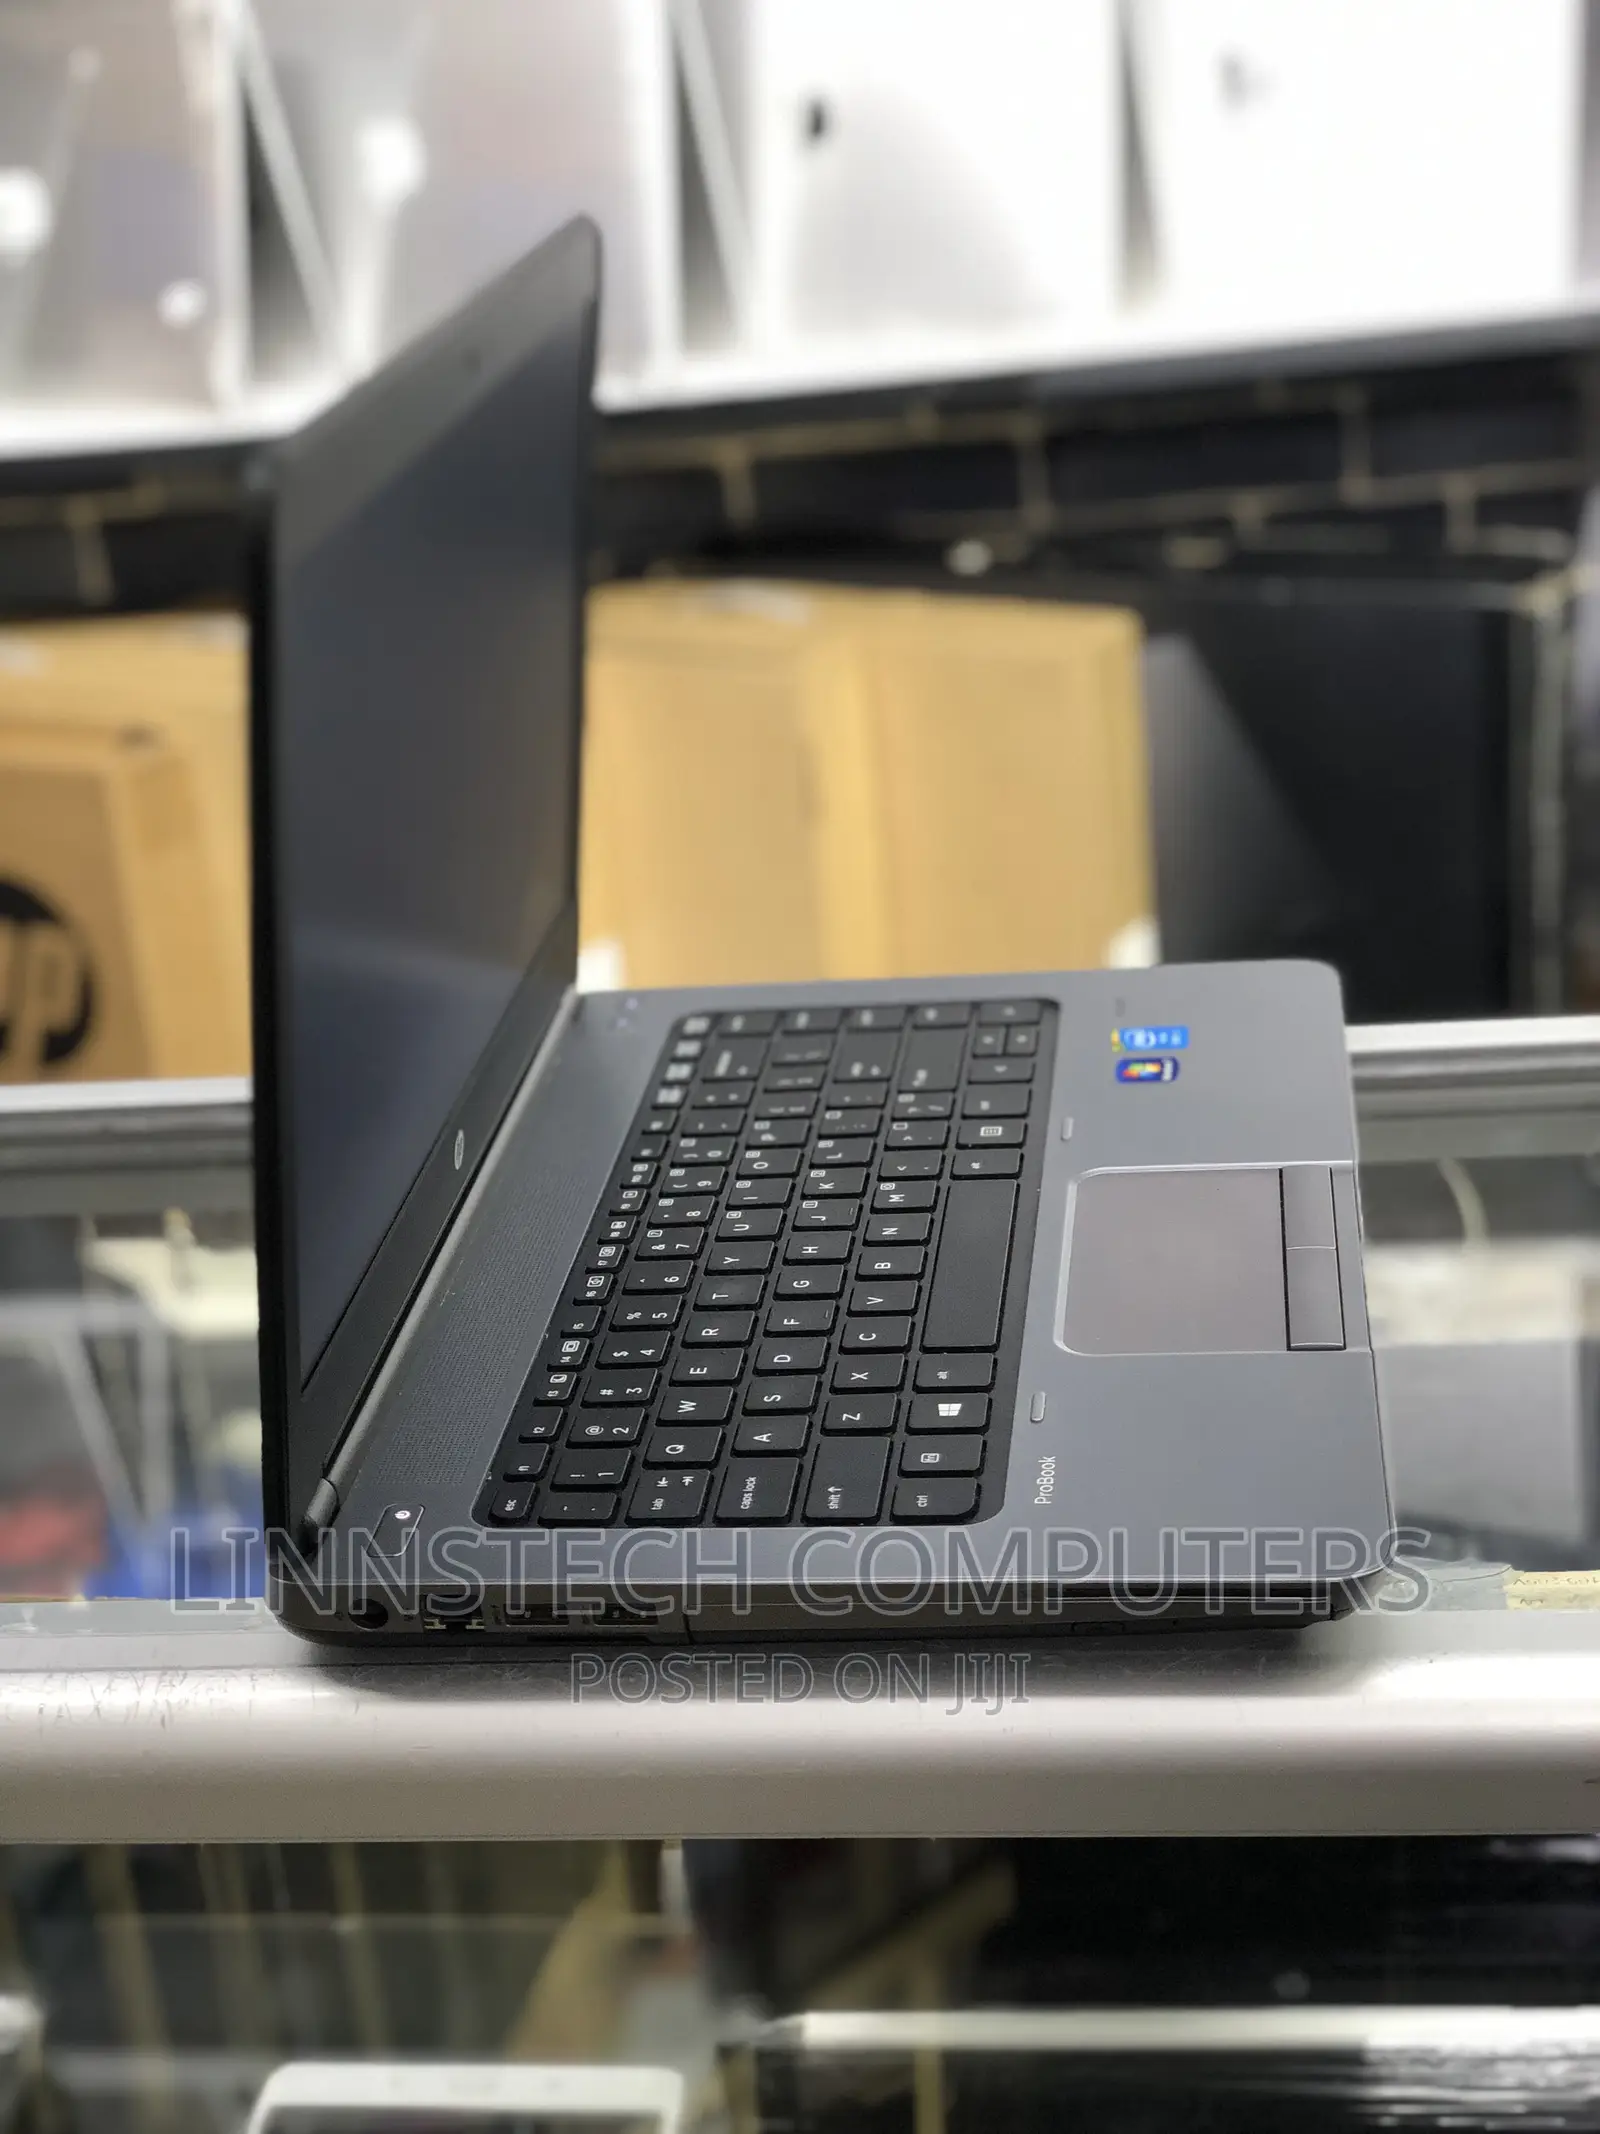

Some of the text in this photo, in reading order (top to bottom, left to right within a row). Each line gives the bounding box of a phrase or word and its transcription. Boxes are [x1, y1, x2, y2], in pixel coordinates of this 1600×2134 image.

[889, 1193, 905, 1202] M
[882, 1227, 898, 1235] N
[723, 1256, 740, 1264] Y
[793, 1280, 810, 1288] G
[866, 1296, 884, 1305] V
[626, 1311, 642, 1320] %
[572, 1322, 584, 1330] f5
[701, 1328, 719, 1336] R
[859, 1332, 876, 1341] C
[640, 1348, 655, 1356] 4
[773, 1354, 791, 1362] D
[689, 1366, 708, 1375] E
[850, 1372, 869, 1380] X
[937, 1371, 948, 1380] alt
[764, 1394, 781, 1402] S
[678, 1400, 697, 1413] W
[842, 1413, 861, 1421] Z
[533, 1426, 545, 1434] f2
[585, 1425, 604, 1435] @
[612, 1426, 629, 1434] 2
[753, 1433, 772, 1442] A
[665, 1444, 684, 1454] Q
[1034, 1456, 1056, 1504] ProBook
[741, 1476, 757, 1509] caps lock
[504, 1499, 517, 1511] esc
[651, 1497, 663, 1510] tab
[828, 1494, 841, 1509] shift
[916, 1495, 928, 1507] ctrl
